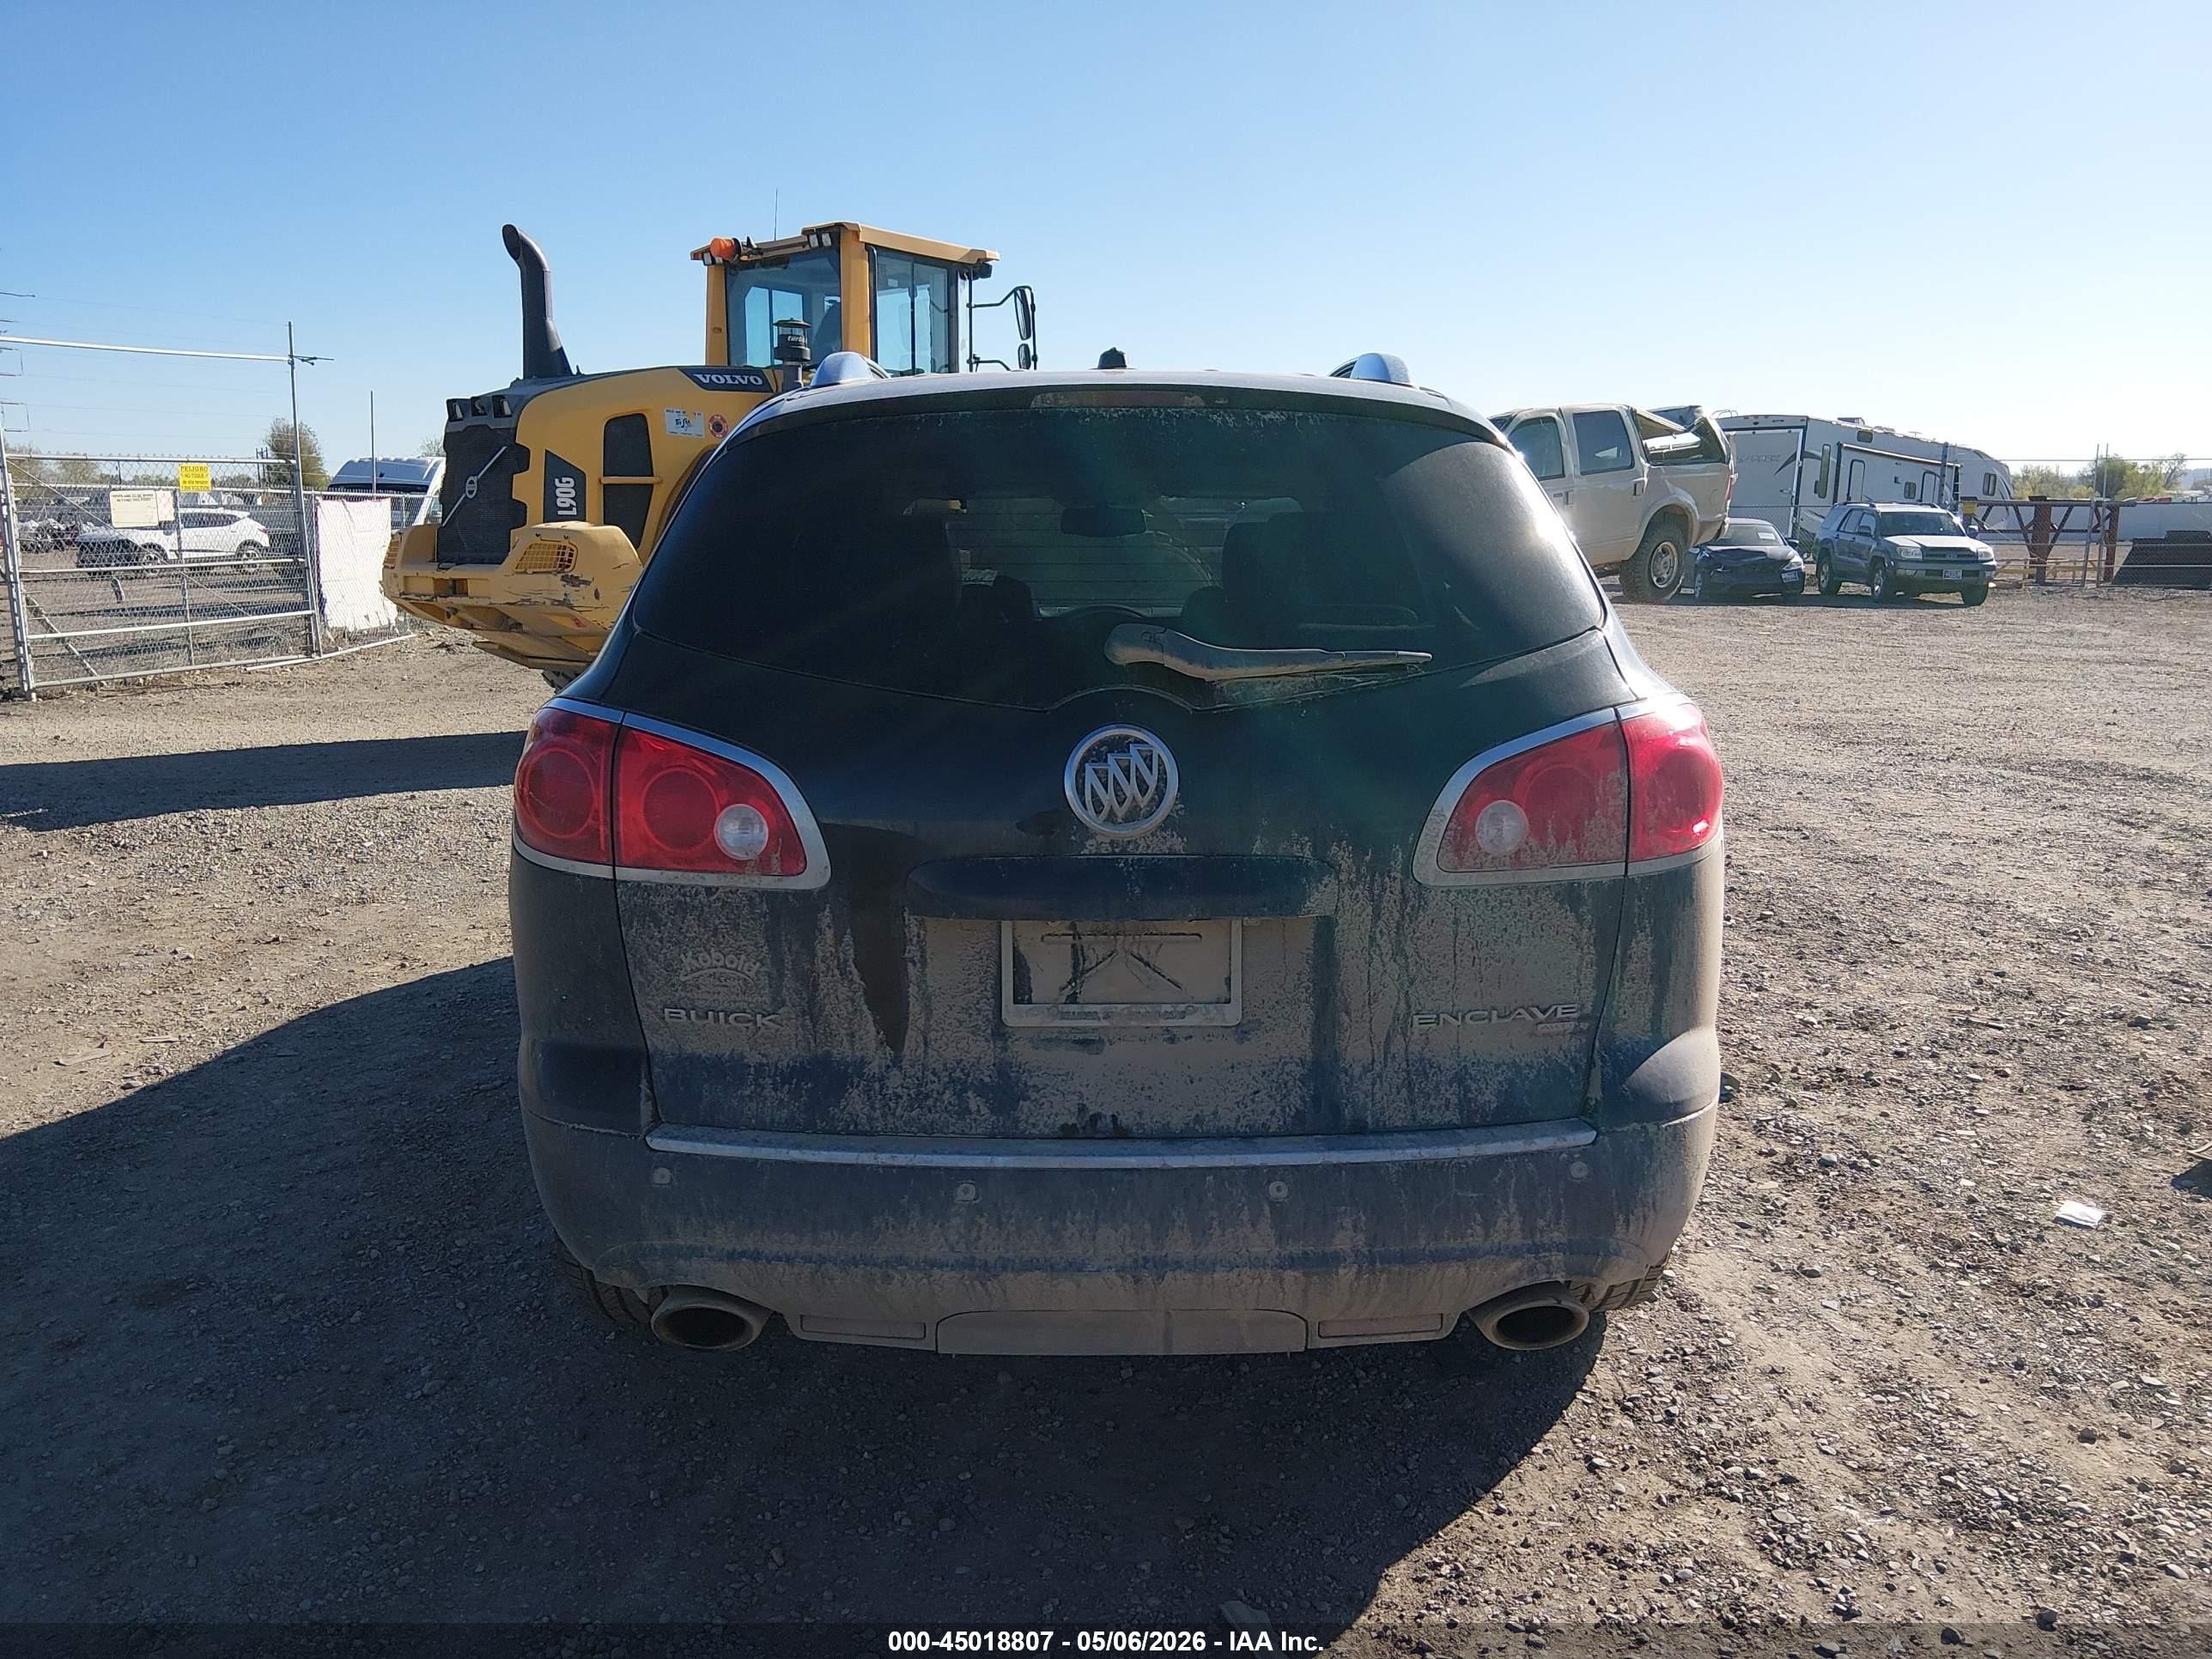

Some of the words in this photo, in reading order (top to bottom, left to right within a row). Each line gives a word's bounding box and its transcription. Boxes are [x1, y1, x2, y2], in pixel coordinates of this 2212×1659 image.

[693, 374, 763, 385] VOLVO
[555, 477, 577, 515] L90G
[664, 1007, 785, 1027] BUICK
[1411, 1003, 1580, 1028] ENCLAVE
